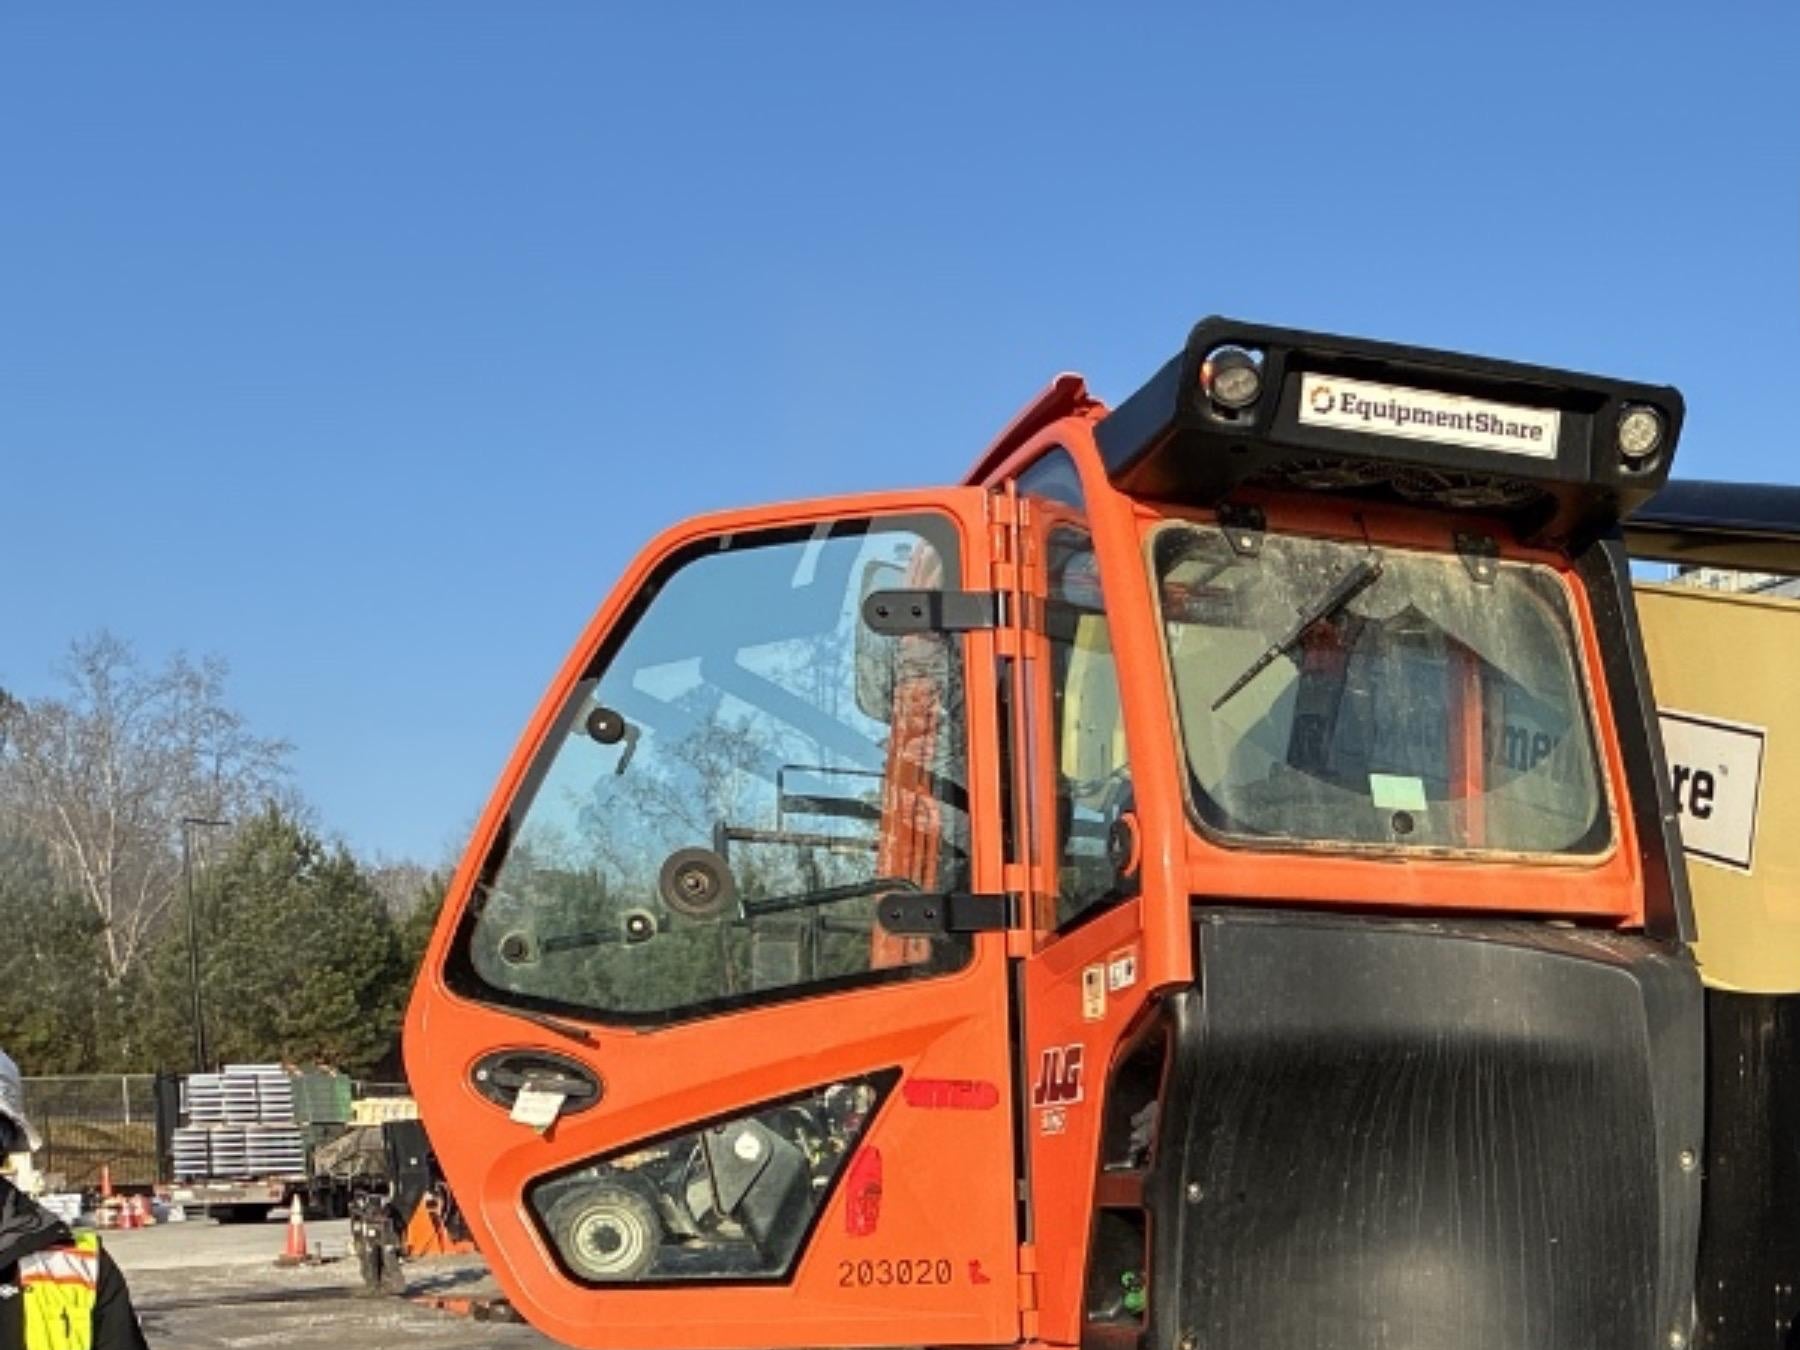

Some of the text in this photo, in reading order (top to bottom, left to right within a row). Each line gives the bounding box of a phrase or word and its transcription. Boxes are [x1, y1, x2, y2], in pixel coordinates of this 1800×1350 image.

[1340, 392, 1543, 441] EquipmentShare
[1032, 1043, 1084, 1108] JLG
[838, 1258, 953, 1288] 203020
